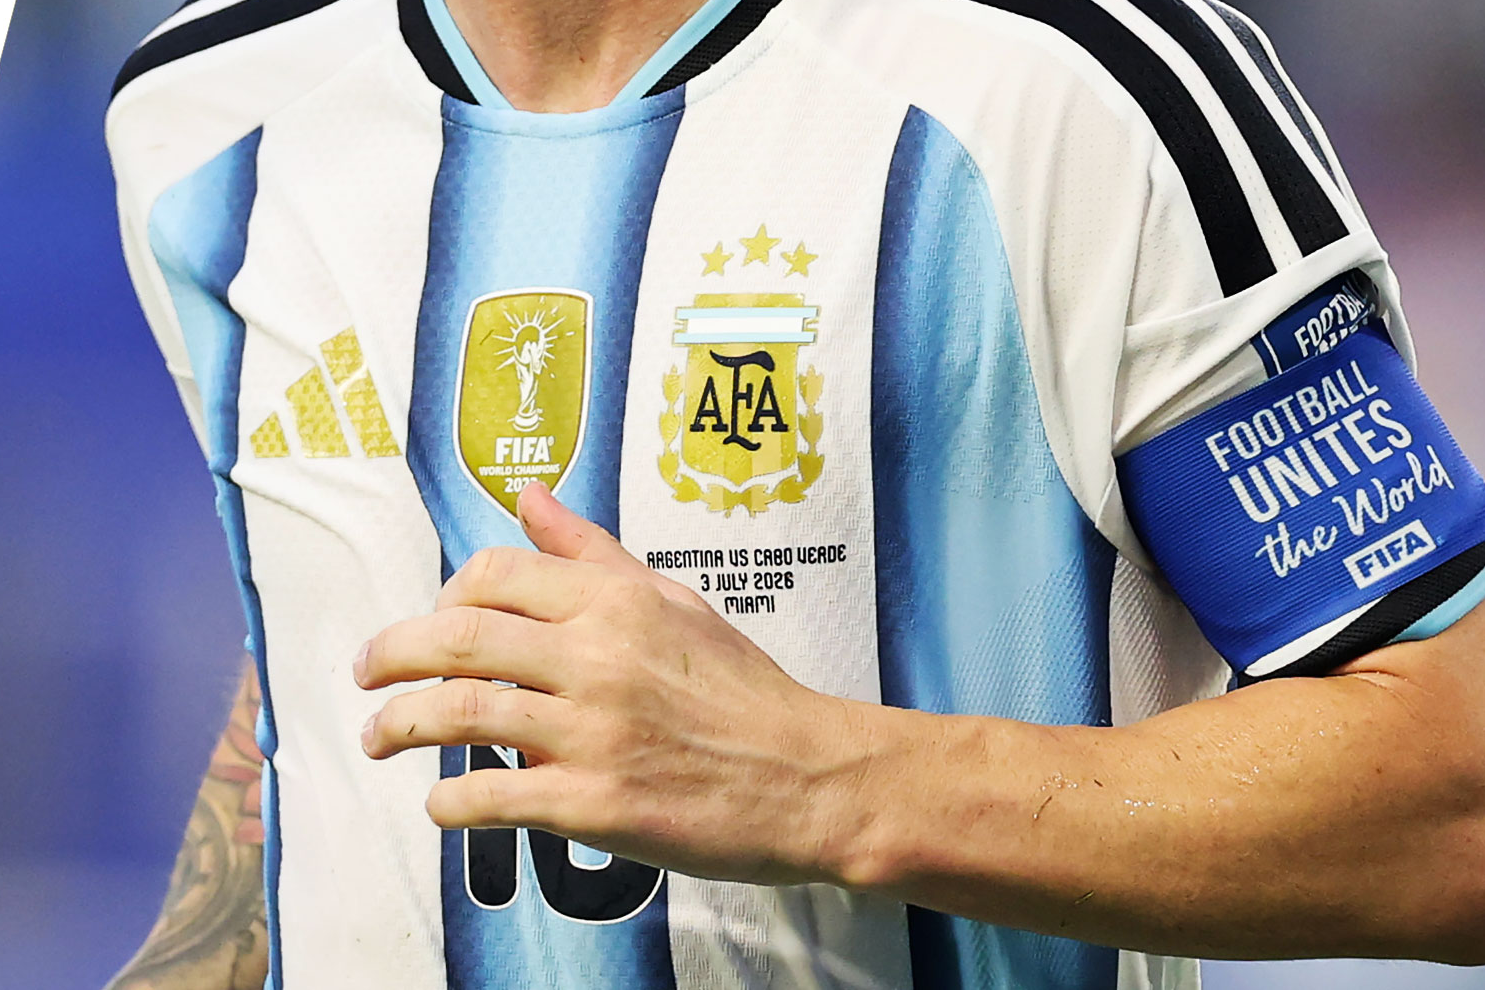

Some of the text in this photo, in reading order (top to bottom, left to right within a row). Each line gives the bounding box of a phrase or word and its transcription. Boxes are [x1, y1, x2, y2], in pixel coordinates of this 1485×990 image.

[1294, 284, 1367, 357] FOOTBA
[689, 349, 789, 451] AFA
[1205, 360, 1379, 472] FOOTBALL
[478, 463, 561, 476] WORLD CHAMPIONS
[1228, 399, 1412, 524] UNITES
[504, 477, 538, 493] 202
[1255, 444, 1455, 578] the World
[647, 544, 847, 569] ARGENTINA VS CABO VERDE
[1356, 531, 1428, 577] FIFA
[700, 571, 794, 592] 3 JULY 2026
[724, 595, 776, 614] MIAMI
